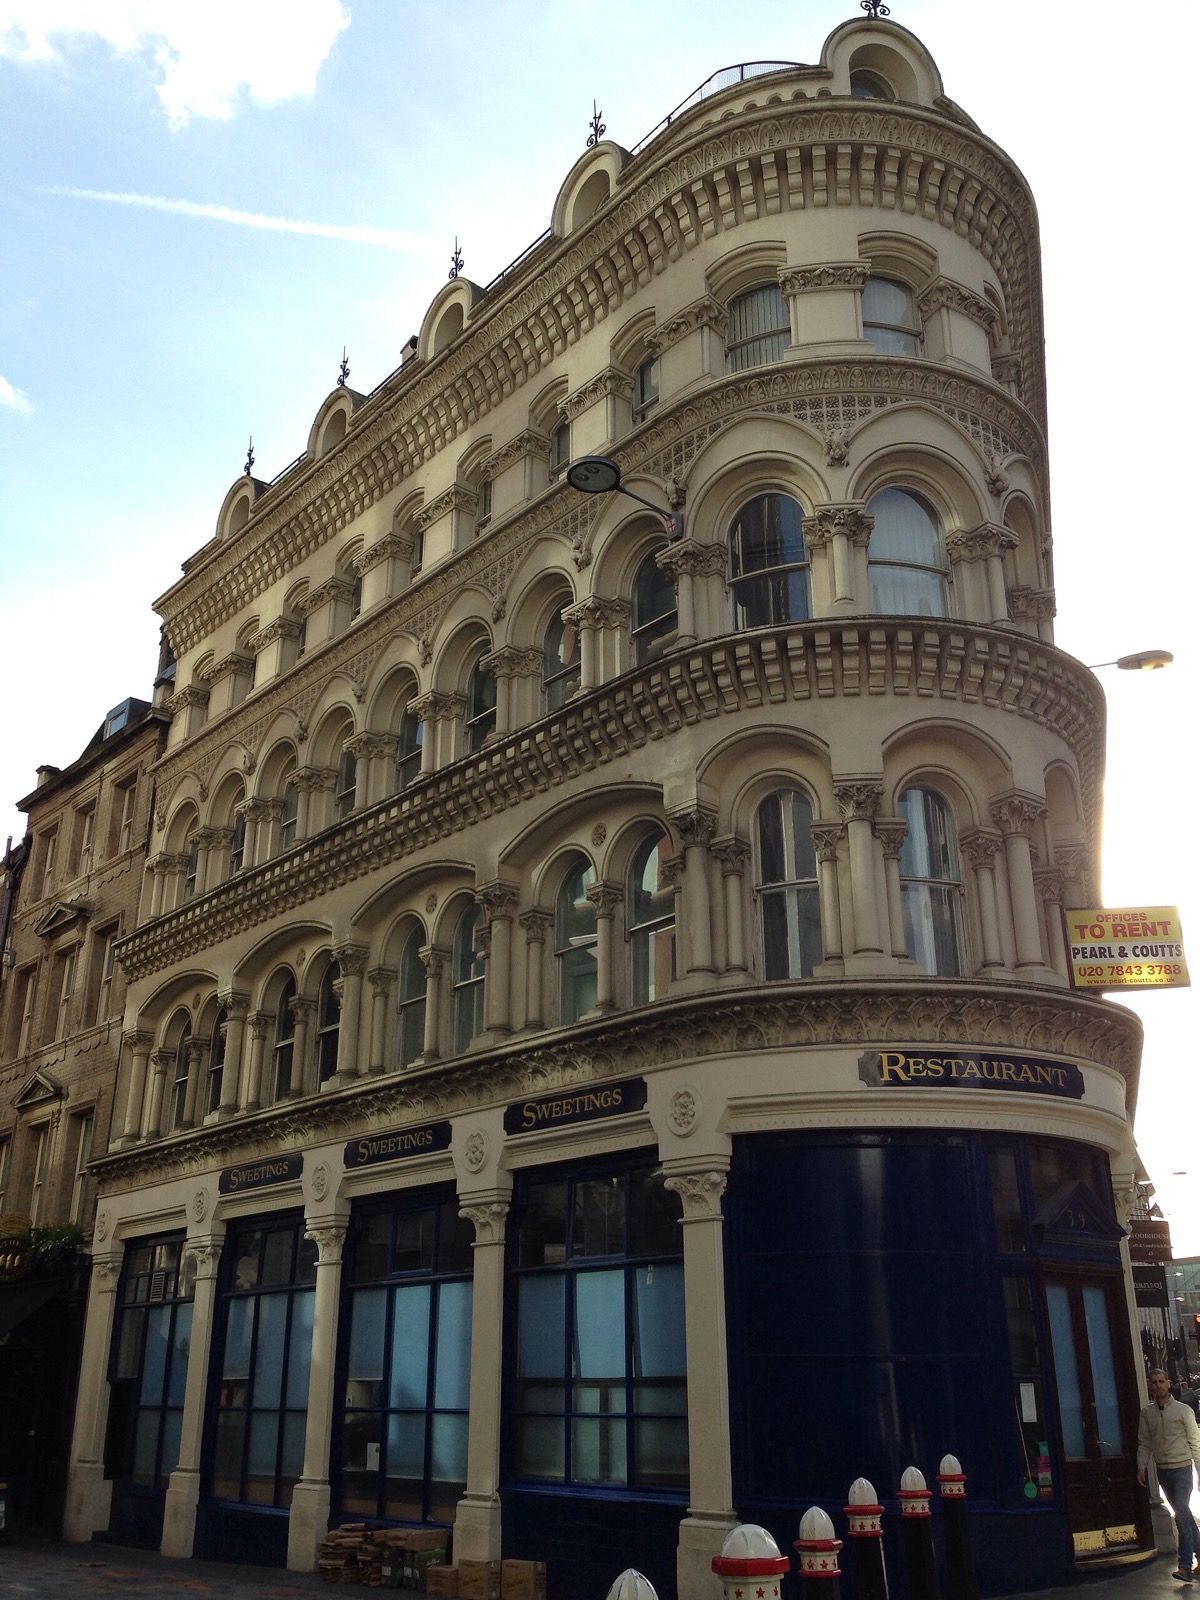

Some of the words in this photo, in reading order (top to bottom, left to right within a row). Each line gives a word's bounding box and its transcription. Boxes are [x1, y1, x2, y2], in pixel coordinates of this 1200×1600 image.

[1095, 912, 1148, 923] OFFICES
[1074, 923, 1106, 940] TO
[1111, 921, 1172, 938] RENT
[1071, 946, 1115, 960] PEARL
[1118, 945, 1128, 958] &
[1132, 944, 1183, 958] COUTTS
[1078, 966, 1104, 977] 020
[1107, 965, 1143, 977] 7843
[1147, 964, 1182, 976] 3788
[1086, 977, 1176, 985] www.pearl-coutts.co.uk
[878, 1051, 1068, 1087] RESTAURANT
[521, 1088, 623, 1128] SWEETINGS
[356, 1129, 434, 1162] SWEETINGS
[228, 1160, 290, 1189] SWEETINGS
